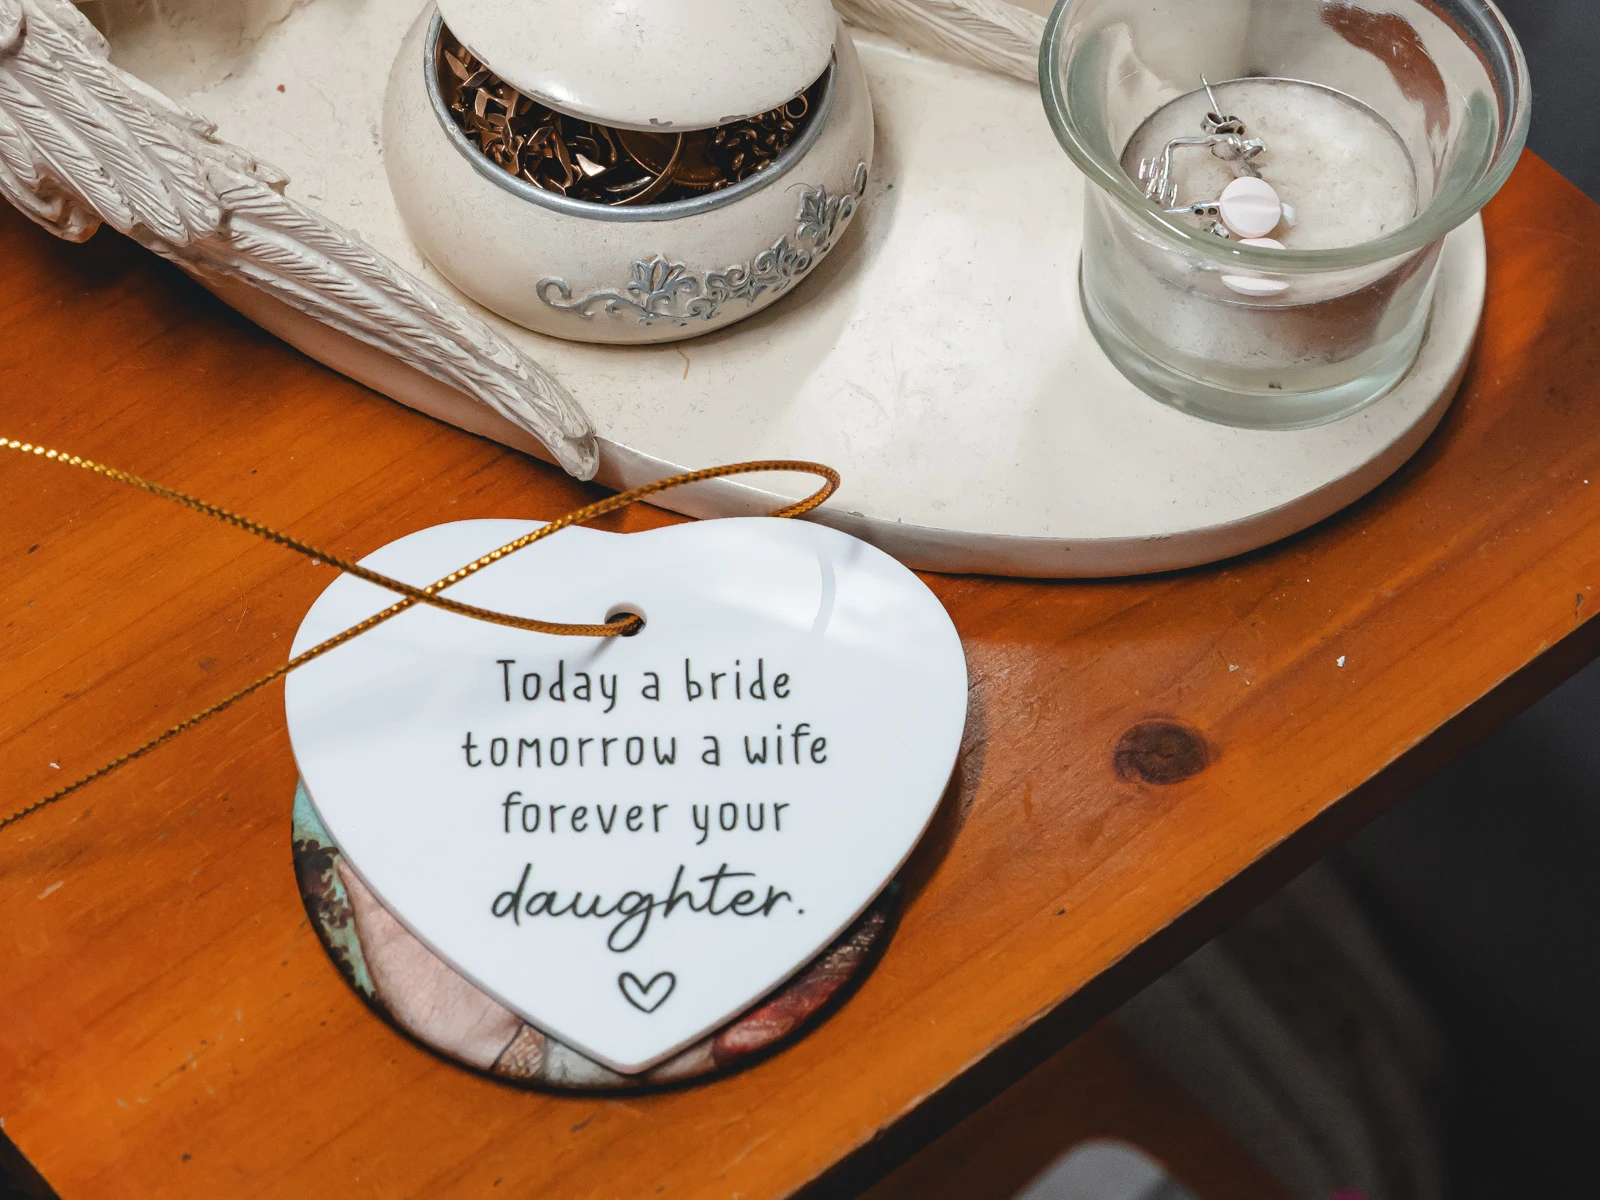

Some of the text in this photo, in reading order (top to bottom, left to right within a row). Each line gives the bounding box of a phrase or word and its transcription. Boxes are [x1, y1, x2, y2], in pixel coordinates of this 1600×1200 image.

[495, 657, 791, 714] Today a bride
[461, 722, 828, 768] tomorrow a wife
[501, 790, 790, 846] forever your
[490, 862, 805, 954] daughter.
